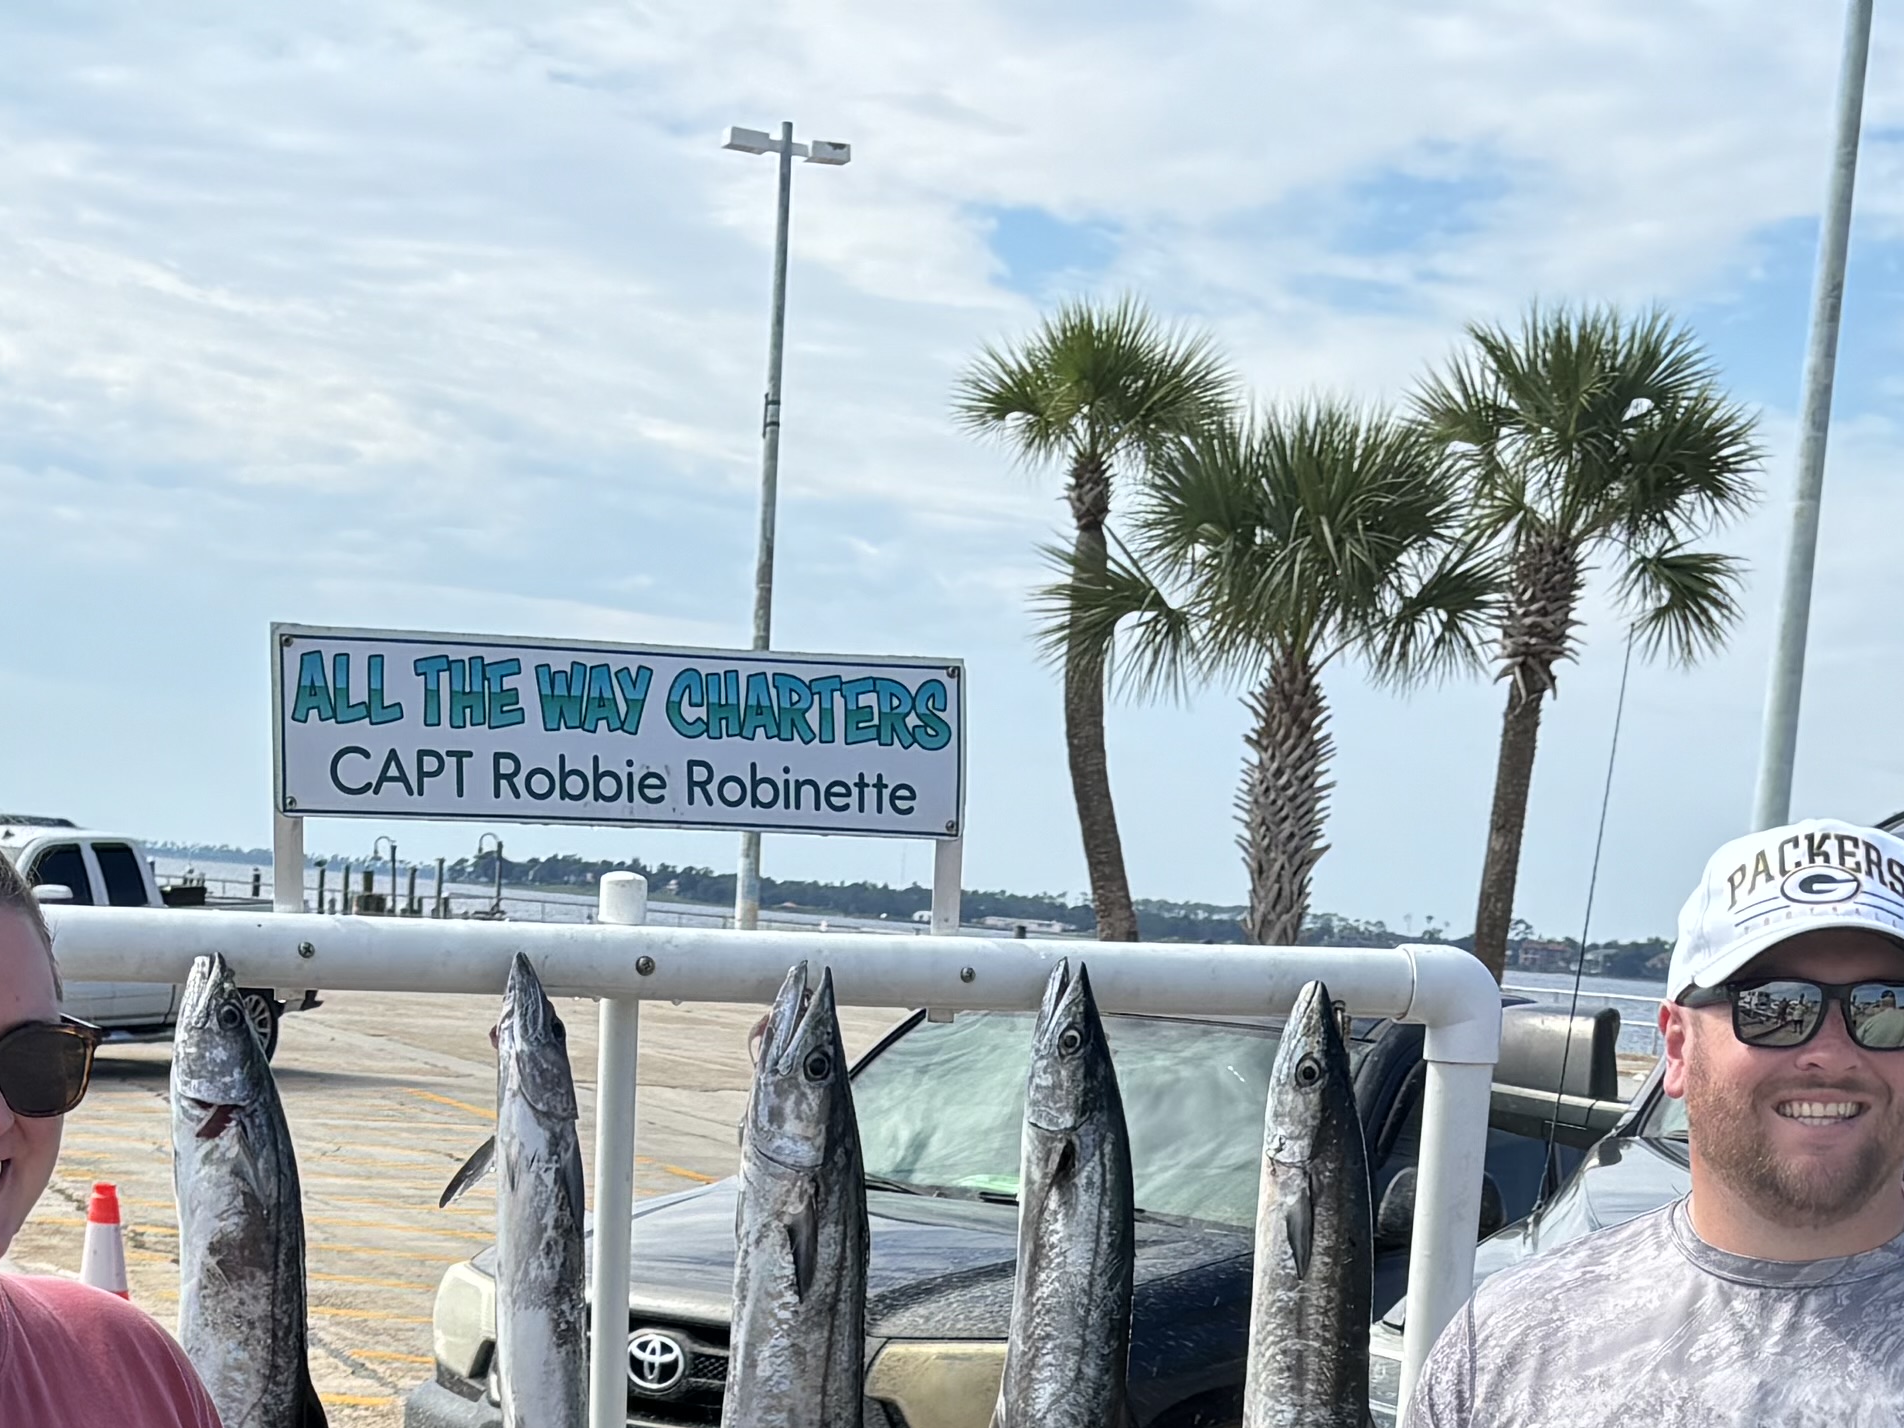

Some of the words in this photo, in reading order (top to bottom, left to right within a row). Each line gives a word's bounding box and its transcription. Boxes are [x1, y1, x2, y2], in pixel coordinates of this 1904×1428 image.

[292, 649, 403, 725] ALL
[414, 654, 526, 729] THE
[534, 663, 654, 736] WAY
[665, 668, 953, 752] CHARTERS
[329, 745, 475, 800] CAPT
[493, 751, 667, 805] Robbie
[687, 759, 917, 816] Robinette
